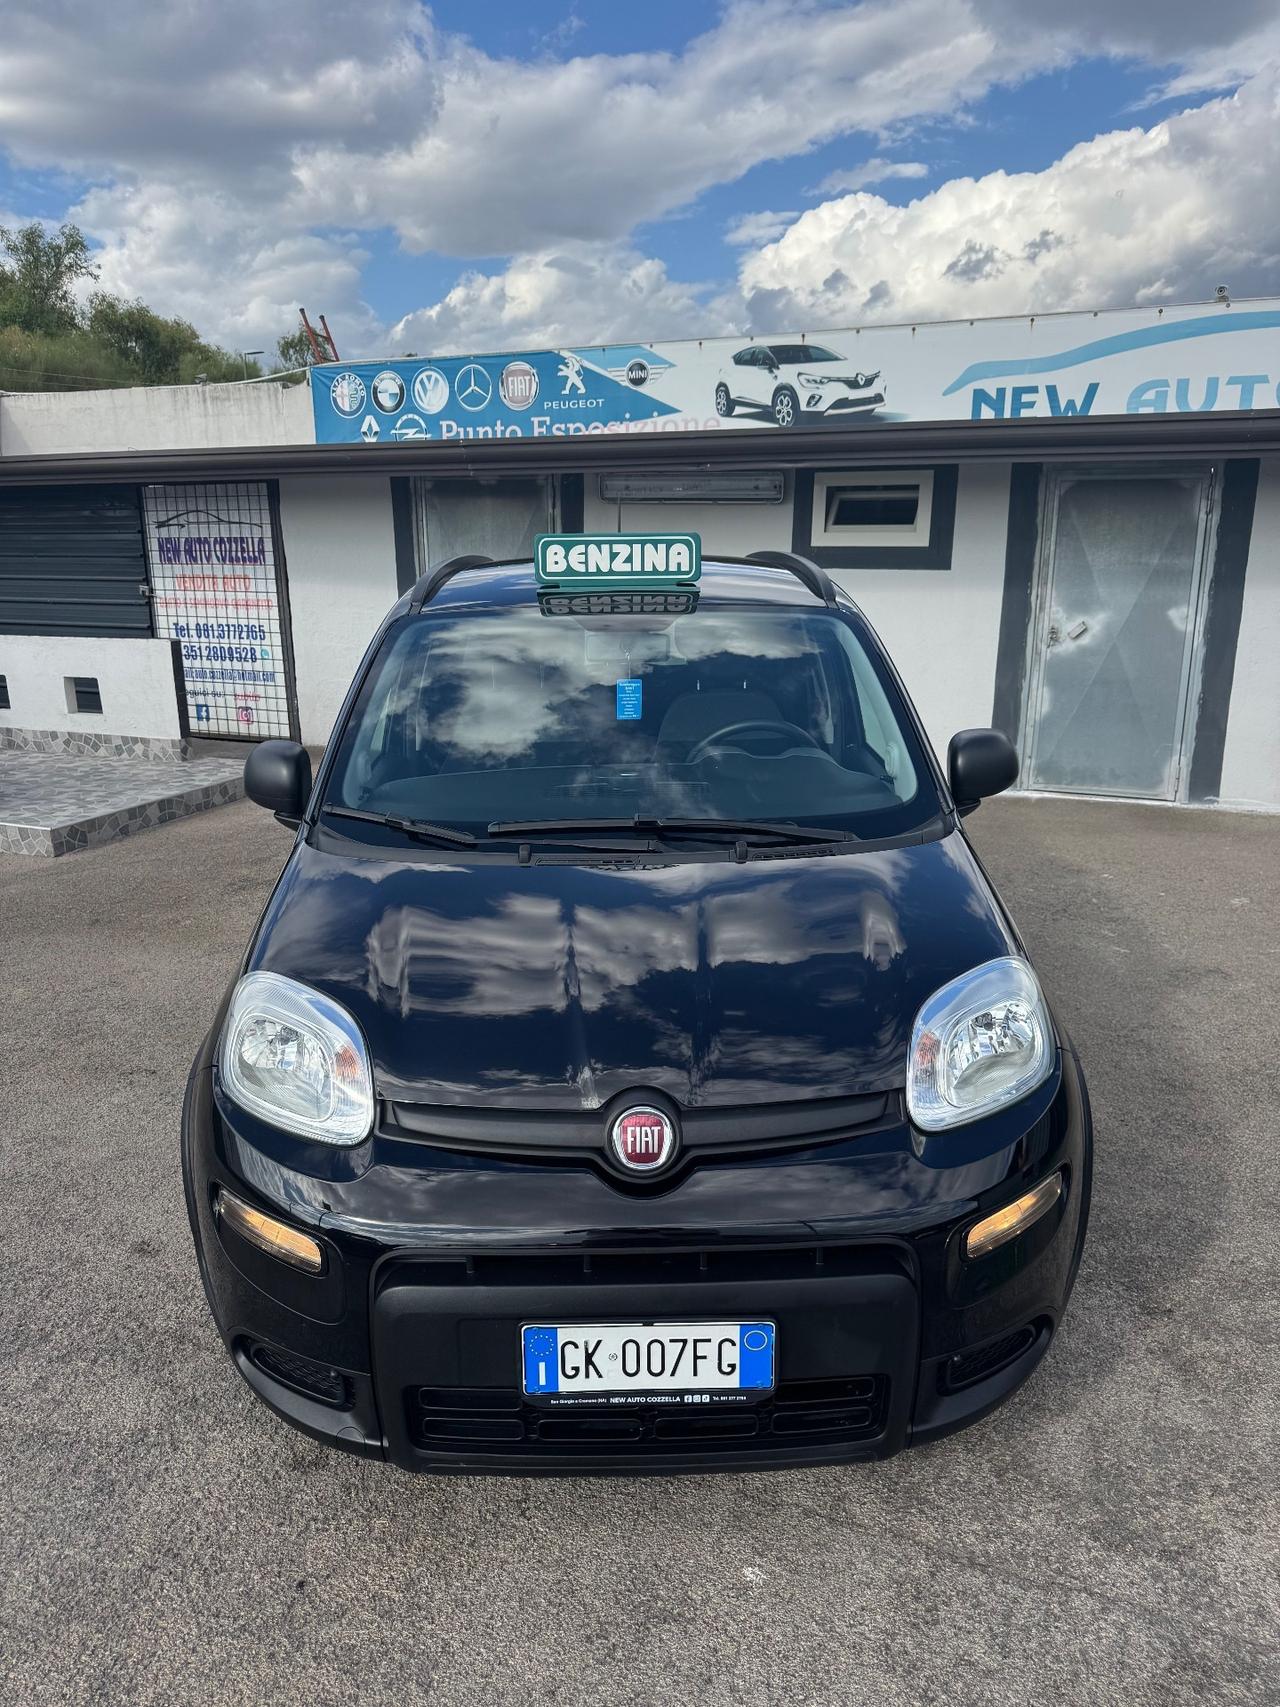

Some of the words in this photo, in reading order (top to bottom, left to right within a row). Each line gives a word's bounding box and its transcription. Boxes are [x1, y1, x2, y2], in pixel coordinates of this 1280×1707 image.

[628, 370, 648, 380] MINI
[508, 375, 531, 397] FIAT
[544, 399, 605, 411] PEUGEOT
[971, 382, 1100, 420] NEW
[1126, 374, 1280, 413] AUT
[440, 419, 522, 440] Punto
[157, 536, 181, 565] NEW
[184, 536, 211, 565] AUTO
[546, 543, 690, 573] BENZINA
[223, 574, 250, 592] AUTO
[173, 623, 194, 639] Tel.
[196, 623, 266, 641] 081.3772765
[184, 645, 203, 661] 351
[205, 645, 258, 663] 2809528
[186, 688, 210, 699] eguici
[626, 1126, 661, 1154] FIAT
[560, 1339, 604, 1380] GK
[621, 1337, 737, 1378] 007FG
[627, 1396, 645, 1404] AUTO
[647, 1395, 681, 1403] COZZELLA
